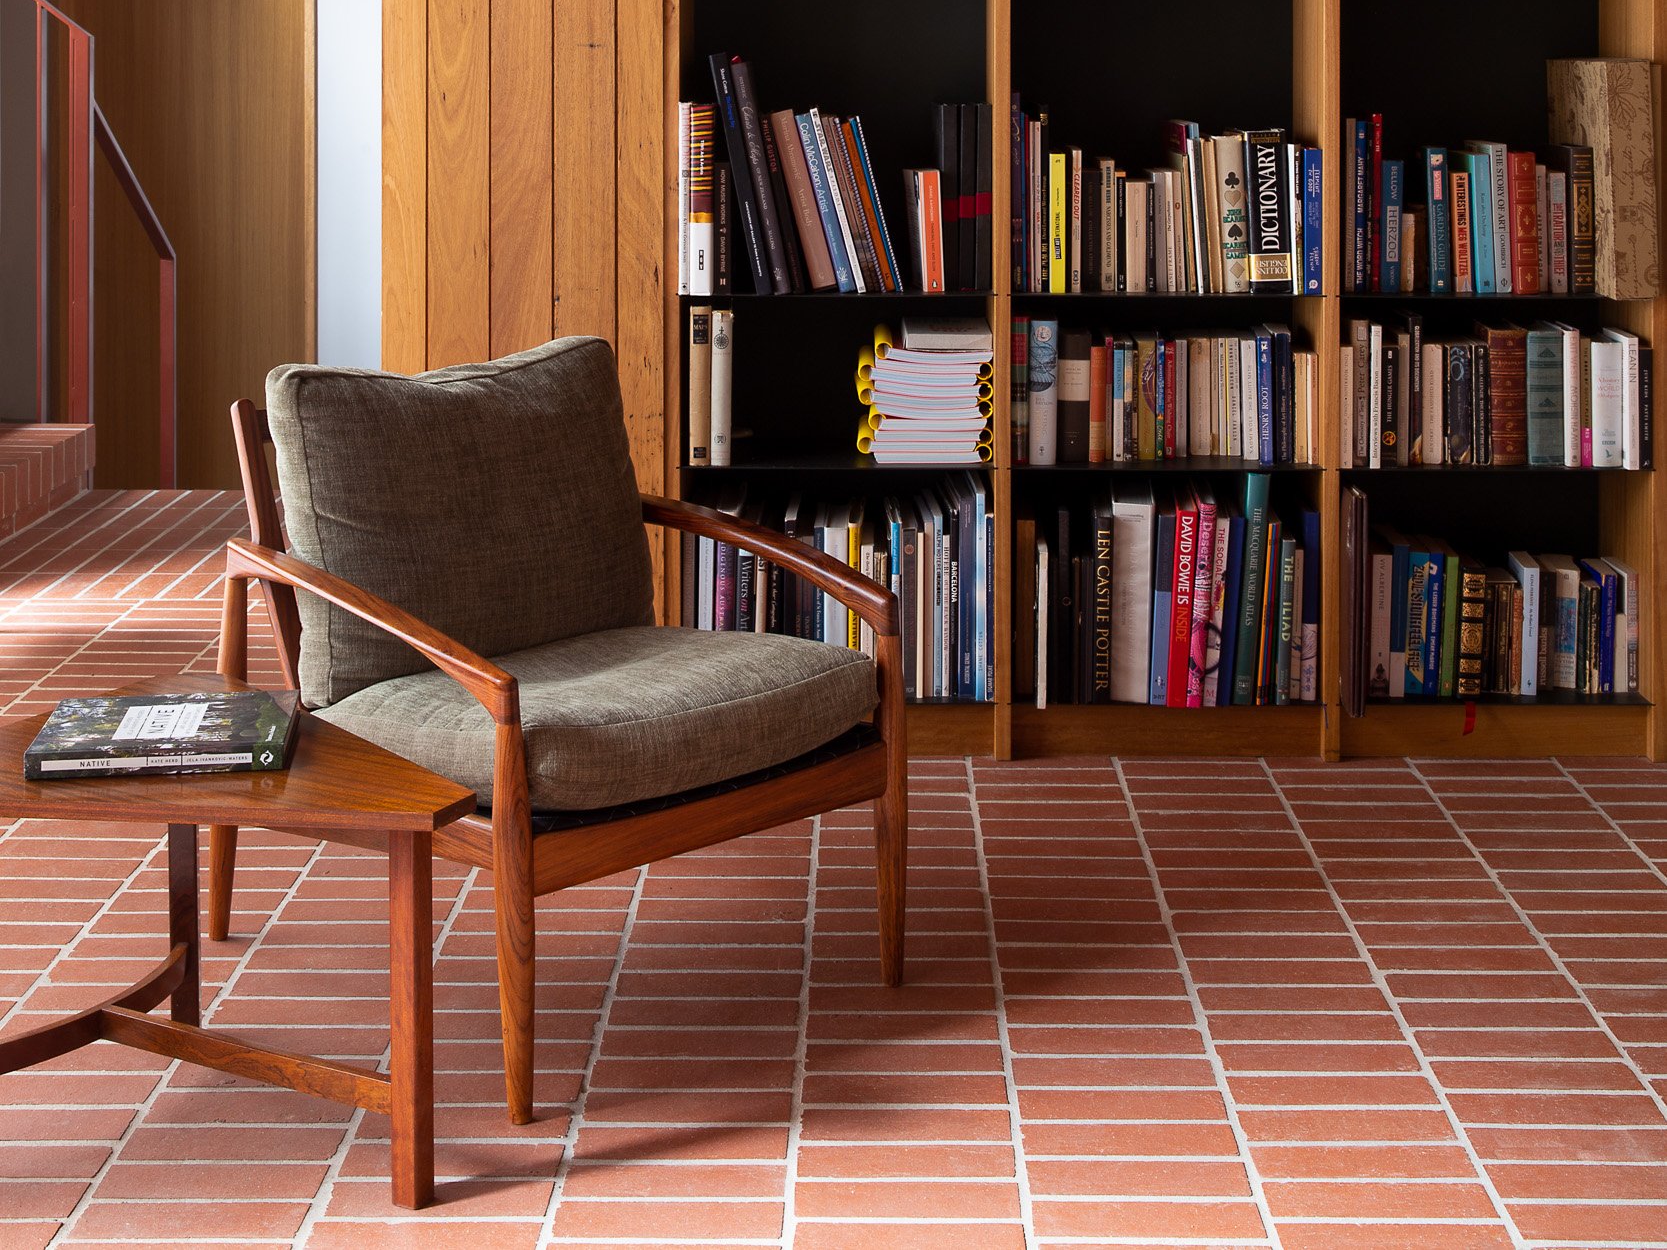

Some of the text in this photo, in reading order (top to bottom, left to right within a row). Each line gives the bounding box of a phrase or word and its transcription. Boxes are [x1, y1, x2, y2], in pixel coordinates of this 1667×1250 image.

[780, 116, 792, 142] Marina
[760, 118, 777, 173] PHILIP GUSTON
[1496, 148, 1504, 164] THE
[800, 122, 829, 212] Colin McCahon: Artist
[1496, 165, 1505, 198] STORY
[798, 187, 808, 206] Artist
[1258, 145, 1280, 250] DICTIONARY
[1498, 199, 1506, 212] OF
[802, 207, 812, 228] Body
[1456, 182, 1470, 276] INTERESTINGS MEG WOLITZER
[1498, 212, 1506, 230] ART
[1388, 210, 1398, 258] HERZOG
[1437, 203, 1446, 272] GARDEN GUIDE
[1256, 267, 1288, 275] COLLINS
[1358, 344, 1366, 368] Carey
[1570, 337, 1578, 352] EXIT
[1629, 344, 1637, 383] LEAN IN
[1217, 528, 1226, 544] THE
[1214, 546, 1225, 578] SOCIAL
[1246, 506, 1262, 626] THE MACQUARIE WORLD ATLAS
[740, 560, 753, 596] Writers
[1176, 516, 1194, 642] DAVID BOWIE IS INSIDE
[1413, 566, 1424, 594] ZADIE
[740, 598, 750, 612] on
[1096, 530, 1110, 691] LEN CASTLE POTTER
[1281, 556, 1294, 640] THE ILIAD
[1410, 627, 1422, 646] FEEL
[1408, 648, 1421, 671] FREE
[1539, 627, 1548, 686] russell banks
[79, 760, 111, 768] NATIVE
